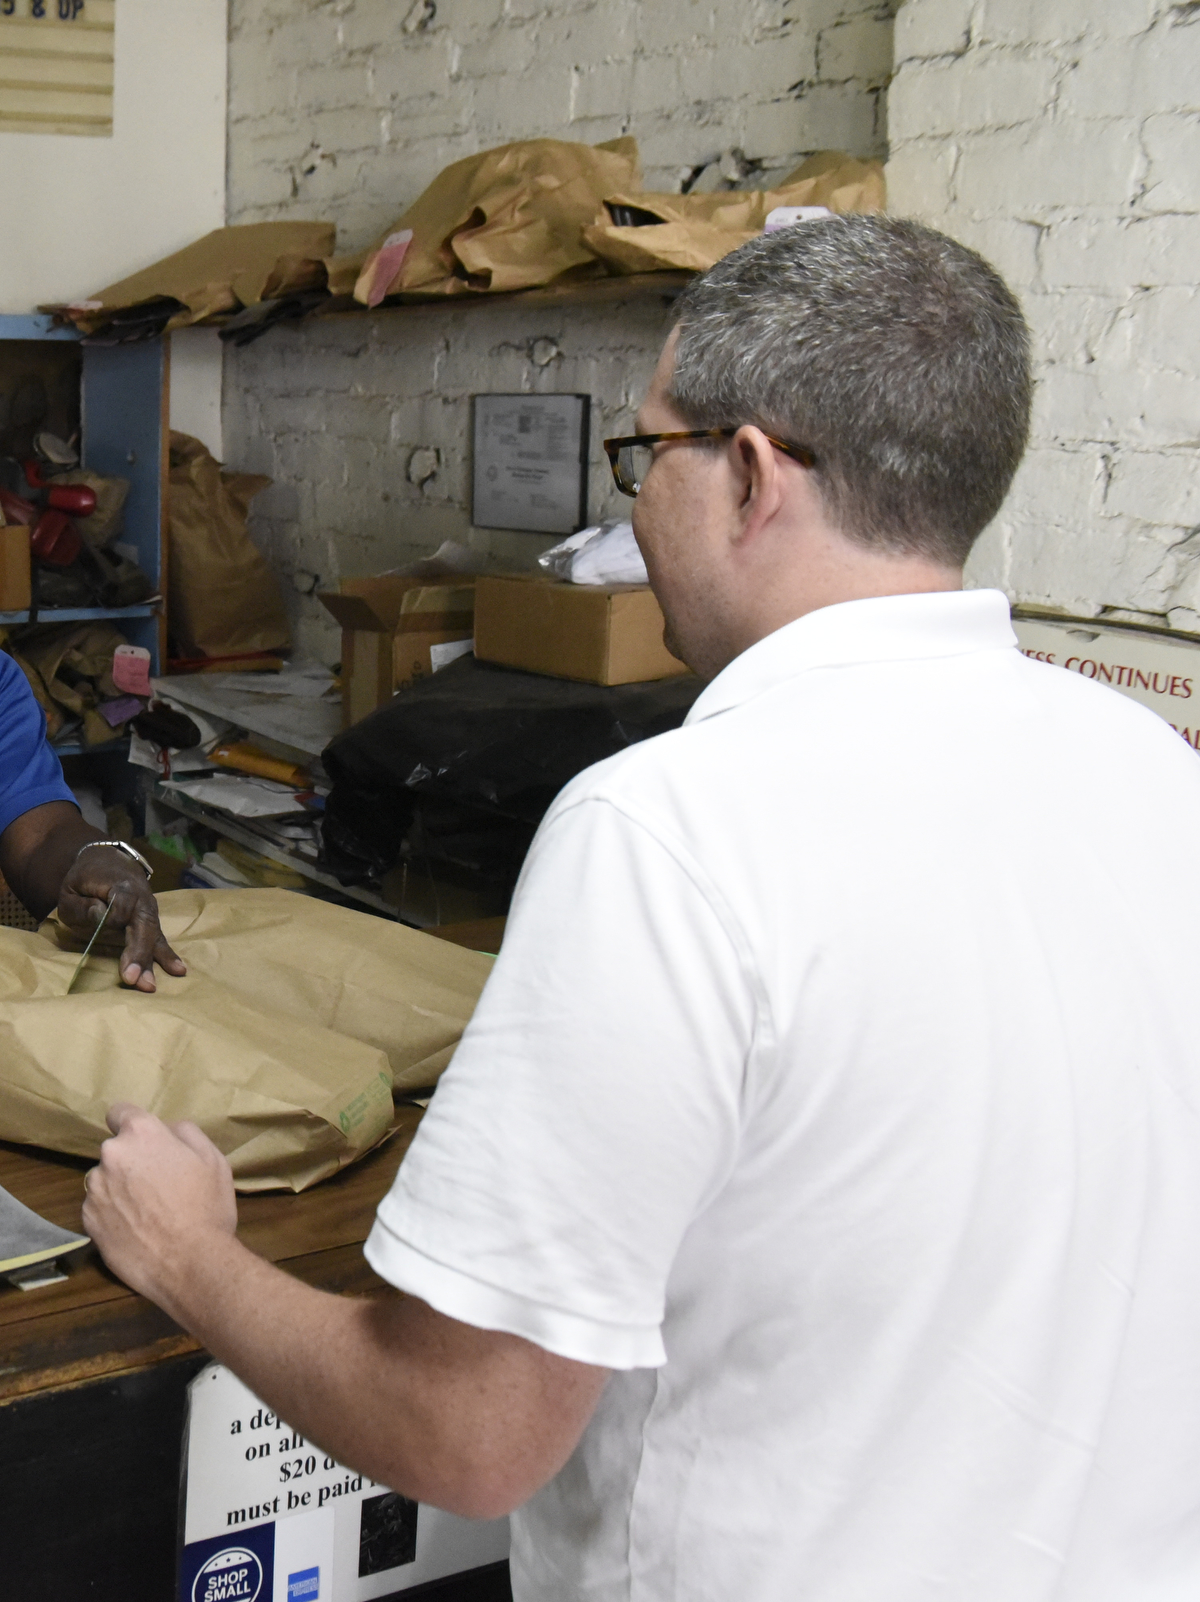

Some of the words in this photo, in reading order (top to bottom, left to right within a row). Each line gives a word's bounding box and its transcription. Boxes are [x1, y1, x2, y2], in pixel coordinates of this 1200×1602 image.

[58, 0, 84, 20] UP
[1064, 657, 1194, 699] CONTINUES
[230, 1419, 242, 1435] a
[245, 1442, 271, 1461] on
[279, 1455, 317, 1483] $20
[226, 1494, 281, 1527] must
[287, 1490, 311, 1511] be
[318, 1474, 363, 1508] paid
[207, 1568, 249, 1590] SHOP
[203, 1580, 252, 1602] SMALL
